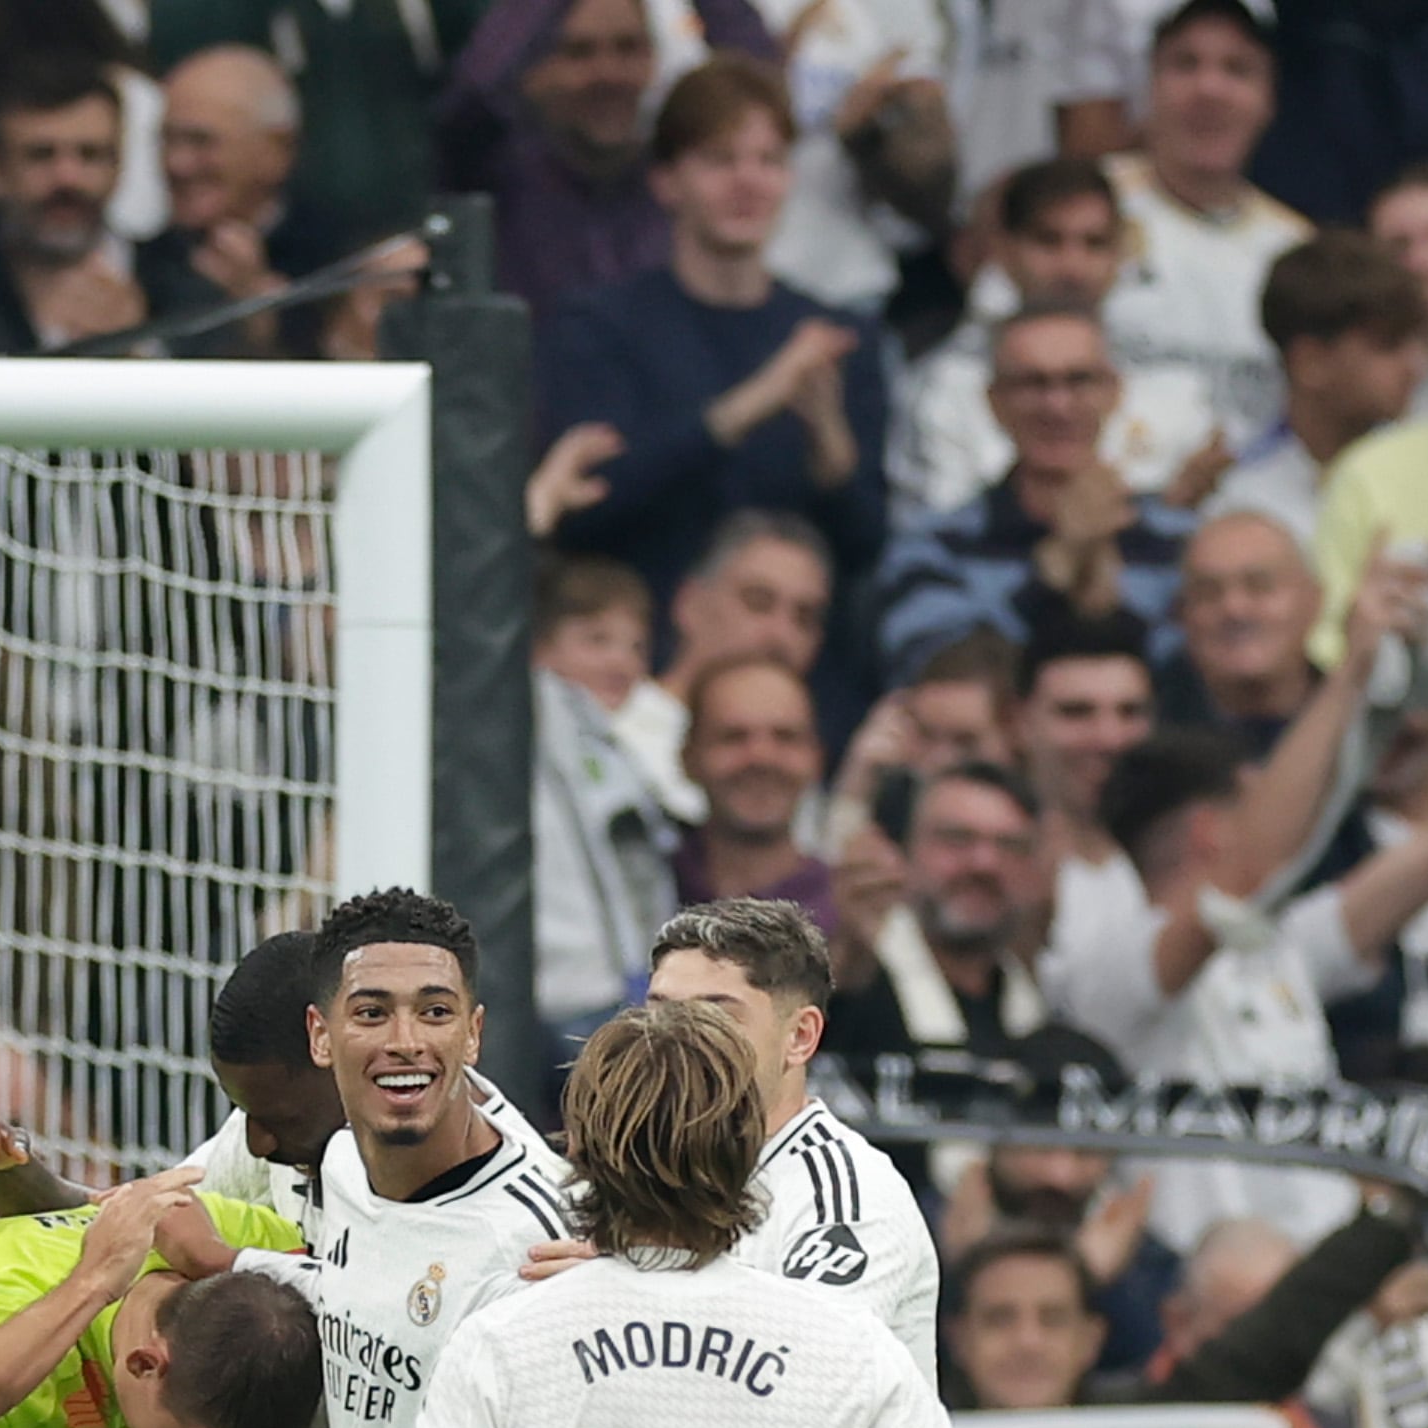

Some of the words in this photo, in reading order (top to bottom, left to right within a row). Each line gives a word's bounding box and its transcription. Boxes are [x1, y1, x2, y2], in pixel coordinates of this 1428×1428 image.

[783, 1226, 867, 1284] hp
[316, 1296, 422, 1392] mirates
[572, 1320, 791, 1397] MODRIĆ
